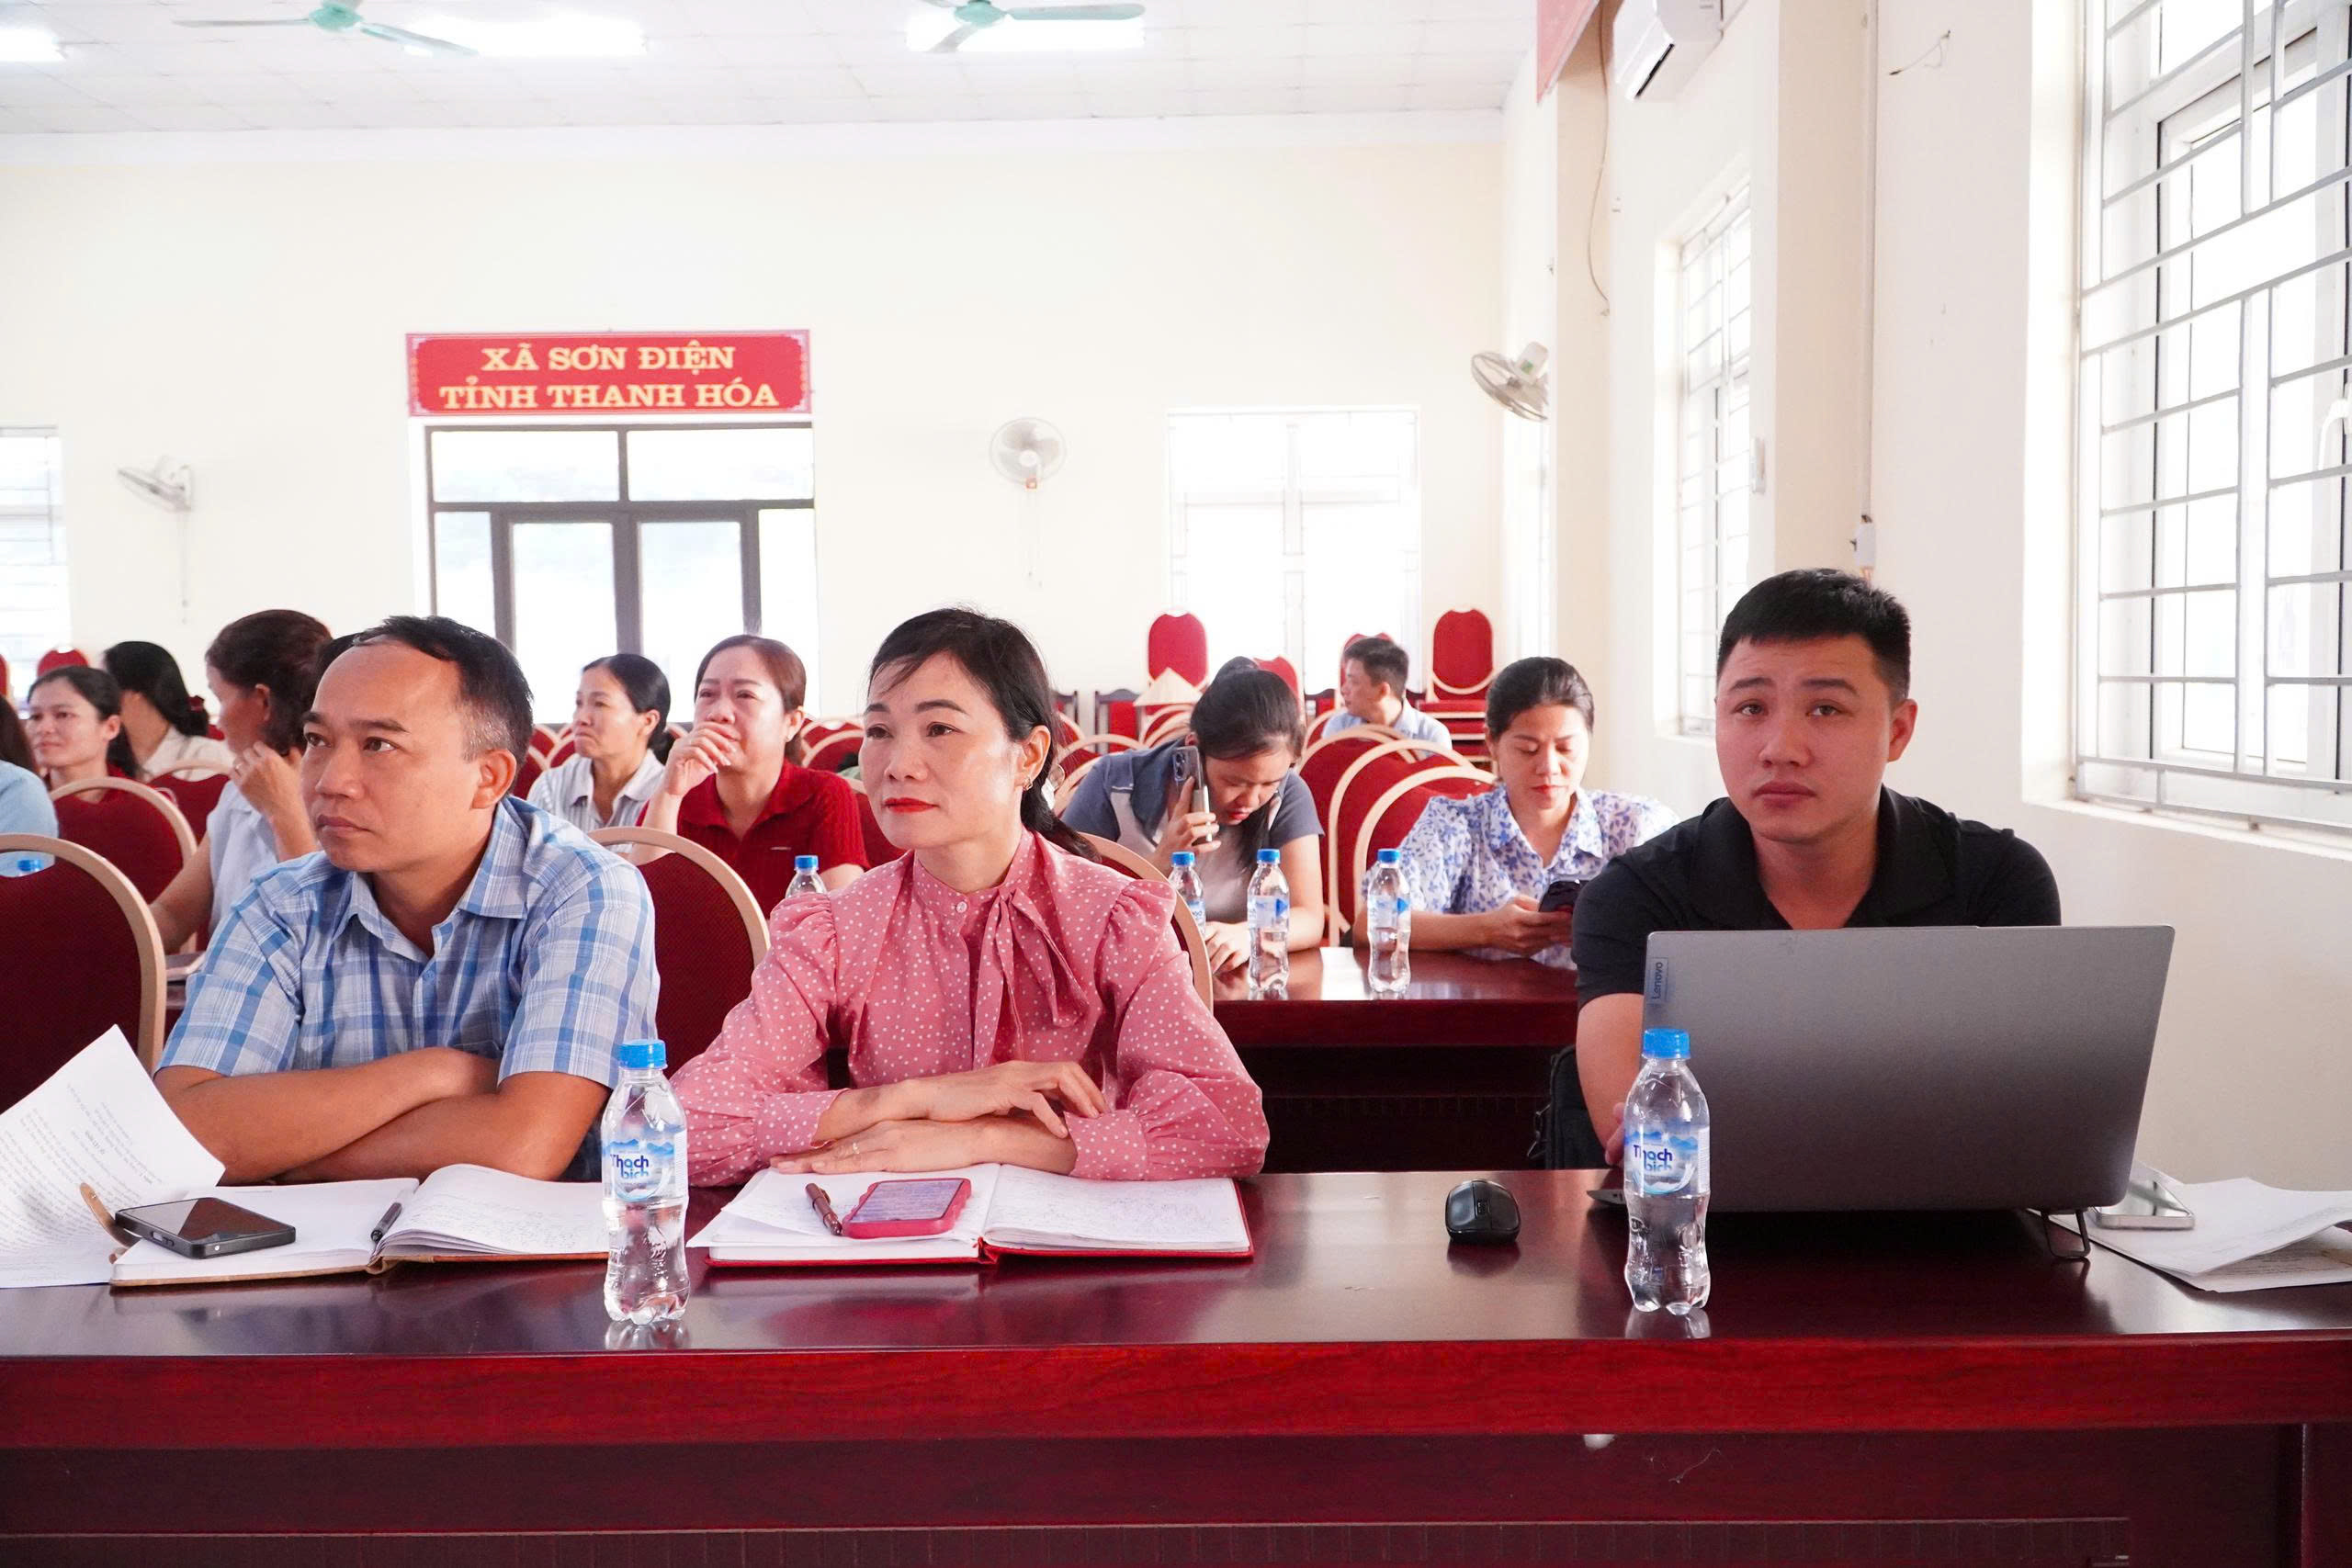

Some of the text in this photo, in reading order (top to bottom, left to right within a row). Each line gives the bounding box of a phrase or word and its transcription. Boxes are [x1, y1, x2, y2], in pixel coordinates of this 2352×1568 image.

[481, 339, 736, 376] XÃ SƠN ĐIỆN
[439, 376, 779, 409] TỈNH THANH HÓA
[1651, 962, 1664, 1000] Lenovo
